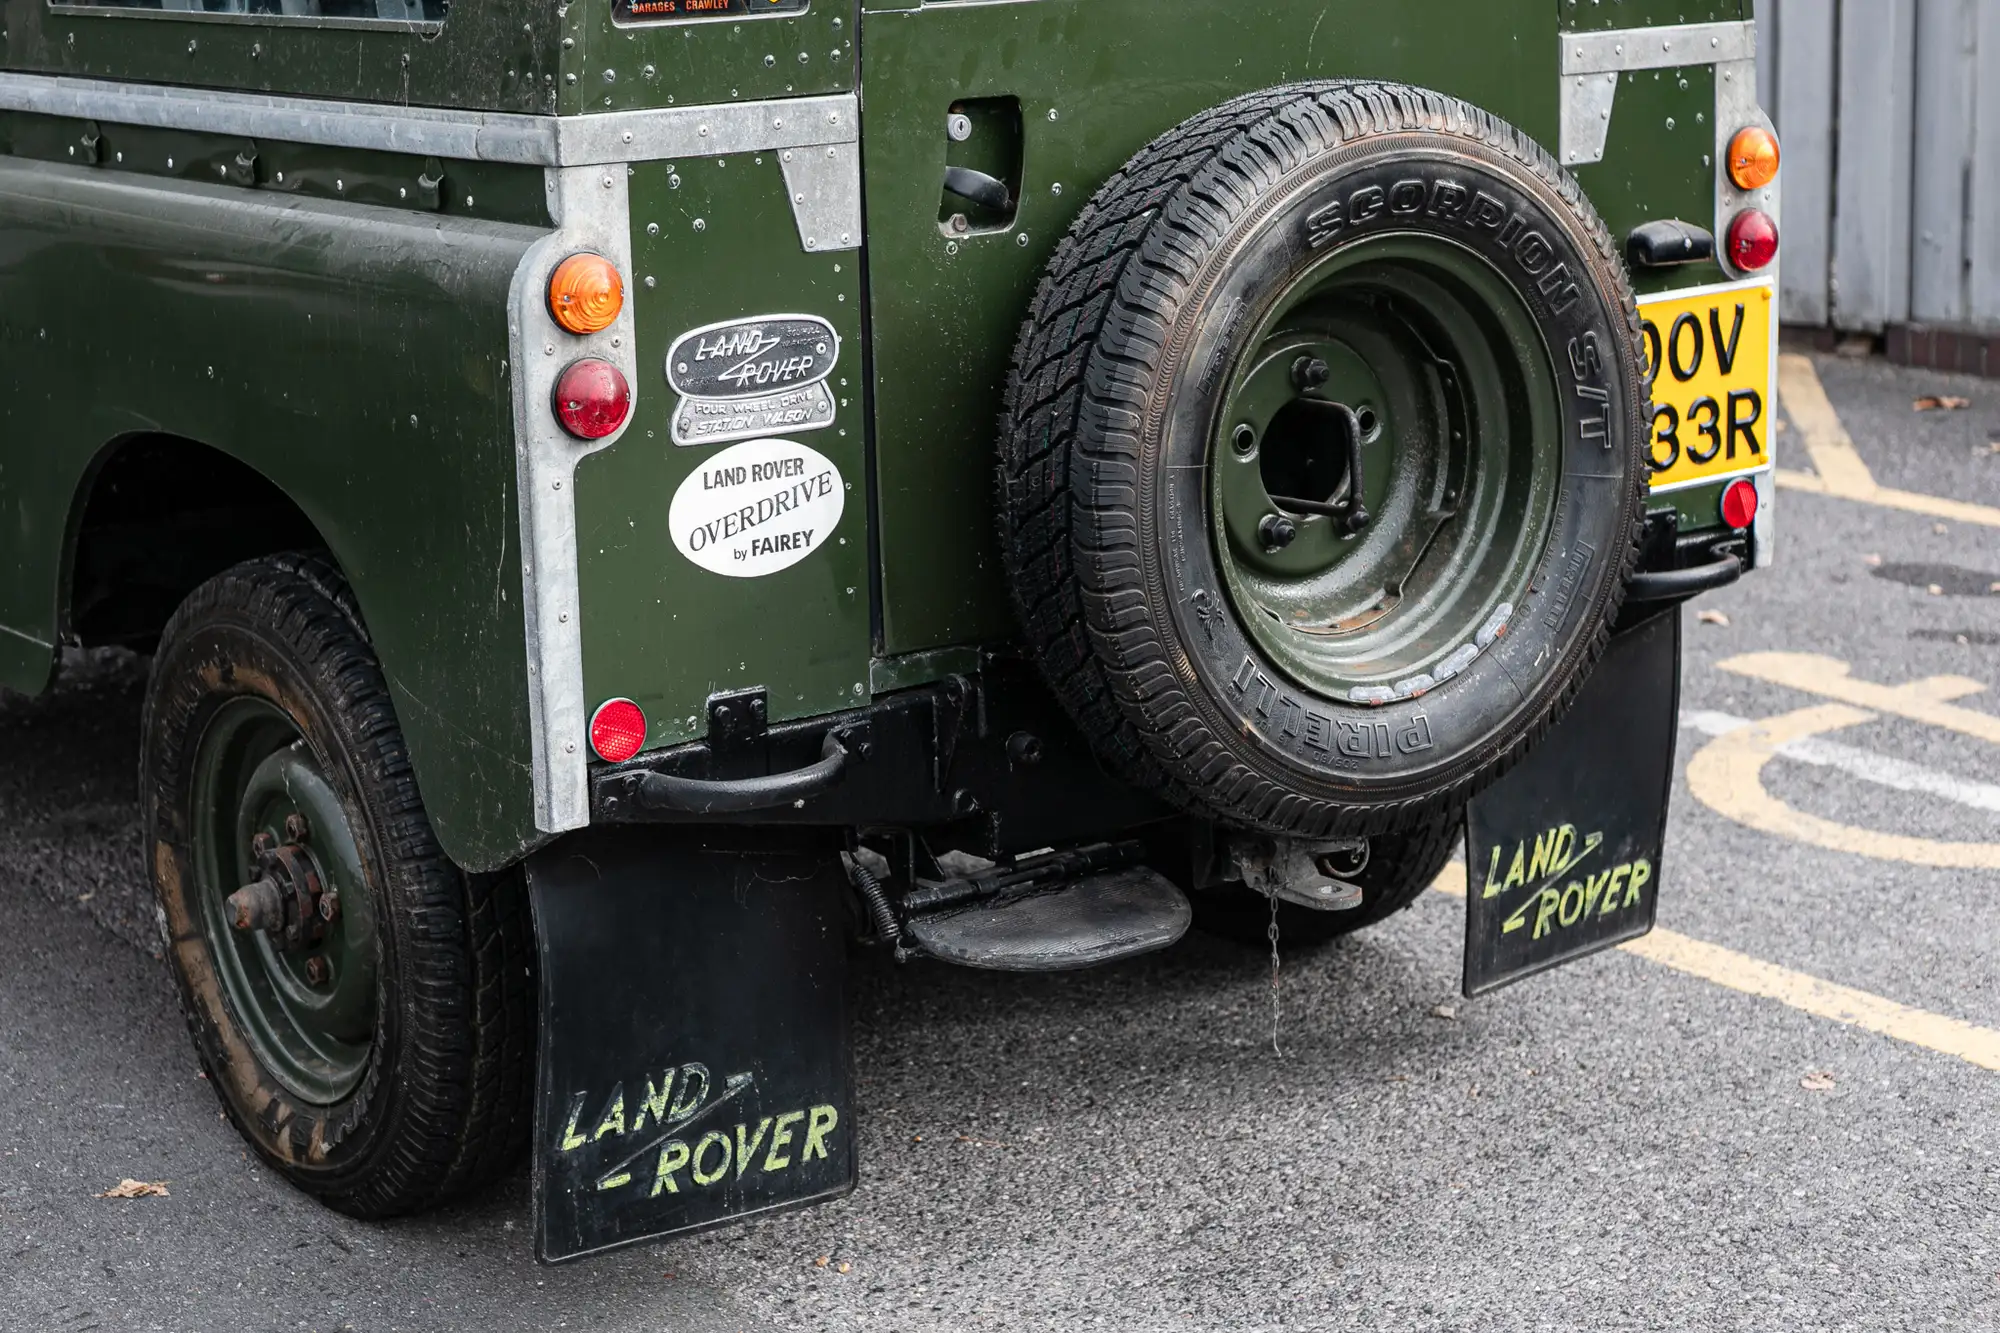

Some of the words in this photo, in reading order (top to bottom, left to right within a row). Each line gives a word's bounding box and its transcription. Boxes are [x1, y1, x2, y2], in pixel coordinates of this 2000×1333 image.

[632, 2, 676, 13] GARAGES
[685, 0, 729, 10] CRAWLEY
[1305, 179, 1582, 317] SCORPION
[695, 330, 764, 361] LAND
[736, 355, 813, 387] ROVER
[694, 403, 727, 416] FOUR
[732, 400, 776, 414] WHEEL
[780, 389, 814, 408] DRIVE
[696, 413, 754, 436] STATION
[763, 408, 813, 427] WAGON
[703, 466, 747, 490] LAND
[752, 457, 804, 483] ROVER
[689, 470, 833, 552] OVERDRIVE
[733, 548, 748, 561] by
[751, 529, 814, 557] FAIREY
[1233, 654, 1434, 759] PIRELLI
[1483, 823, 1577, 899] LAND
[1532, 858, 1651, 940] ROVER
[557, 1062, 710, 1151] LAND
[650, 1104, 838, 1198] ROVER
